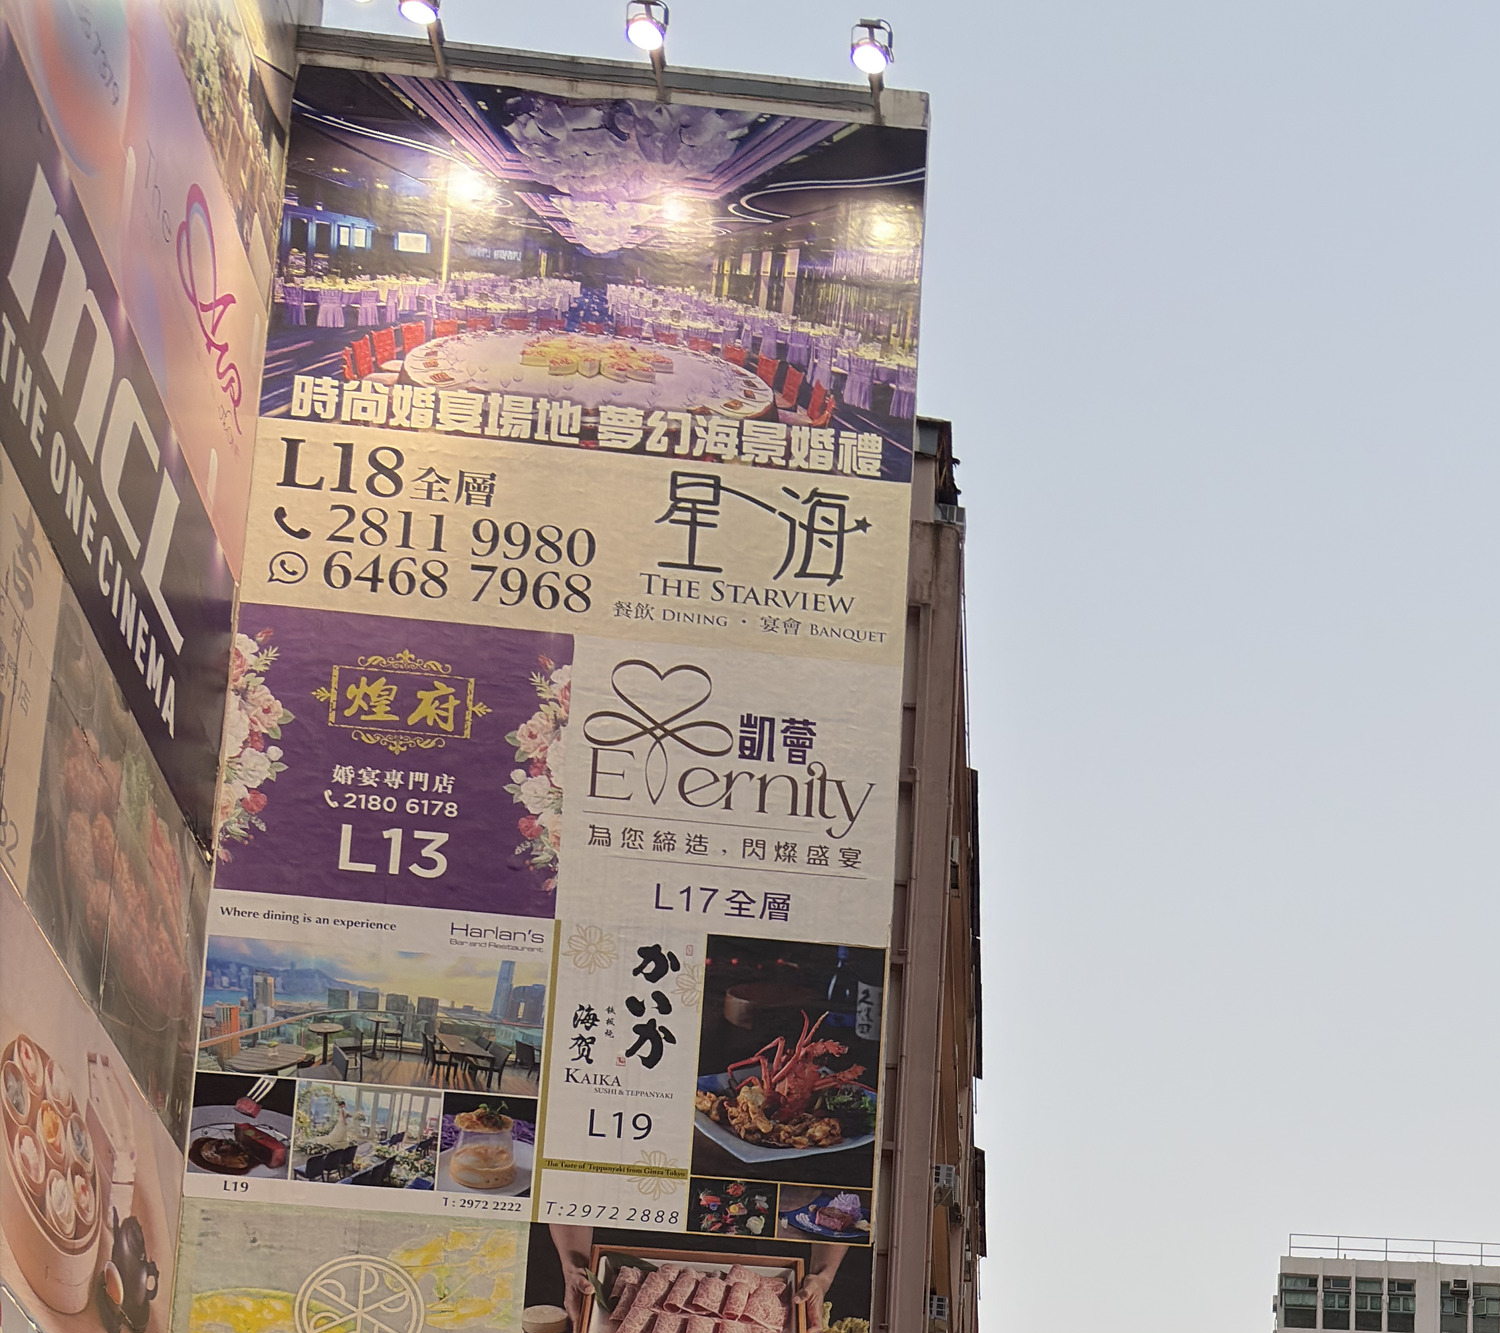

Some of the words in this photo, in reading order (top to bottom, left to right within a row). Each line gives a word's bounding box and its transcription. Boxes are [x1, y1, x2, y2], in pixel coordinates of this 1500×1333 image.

[290, 373, 582, 447] 時尚婚宴場地
[598, 404, 883, 477] 夢幻海景婚禮
[1, 312, 45, 459] THE
[48, 431, 98, 567] ONE
[97, 533, 177, 740] CINEMA
[326, 504, 448, 555] 2811
[470, 517, 597, 567] 9980
[323, 550, 449, 600] 6468
[470, 563, 593, 614] 7968
[639, 572, 701, 601] THE
[710, 578, 855, 616] STARVIEW
[613, 600, 656, 624] 餐飲
[661, 609, 728, 629] DINING
[759, 613, 801, 638] 宴會
[809, 622, 887, 645] BANQUET
[343, 676, 462, 733] 煌府
[331, 763, 456, 796] 婚宴專門店
[342, 791, 398, 815] 2180
[405, 796, 459, 820] 6178
[336, 822, 451, 880] L13
[220, 906, 260, 920] Where
[263, 908, 300, 926] dining
[302, 913, 312, 925] is
[315, 915, 330, 927] an
[333, 917, 398, 934] experience
[449, 921, 546, 945] Harlan's
[449, 938, 469, 949] Bar
[625, 943, 681, 1070] かいか
[564, 1067, 622, 1089] KAIKA
[594, 1087, 617, 1097] SUSHI
[626, 1089, 674, 1101] TEPPANYAKI
[587, 1107, 653, 1142] L19
[223, 1180, 249, 1194] L19
[460, 1197, 490, 1211] 2972
[493, 1200, 523, 1213] 2222
[626, 1206, 680, 1226] 2888
